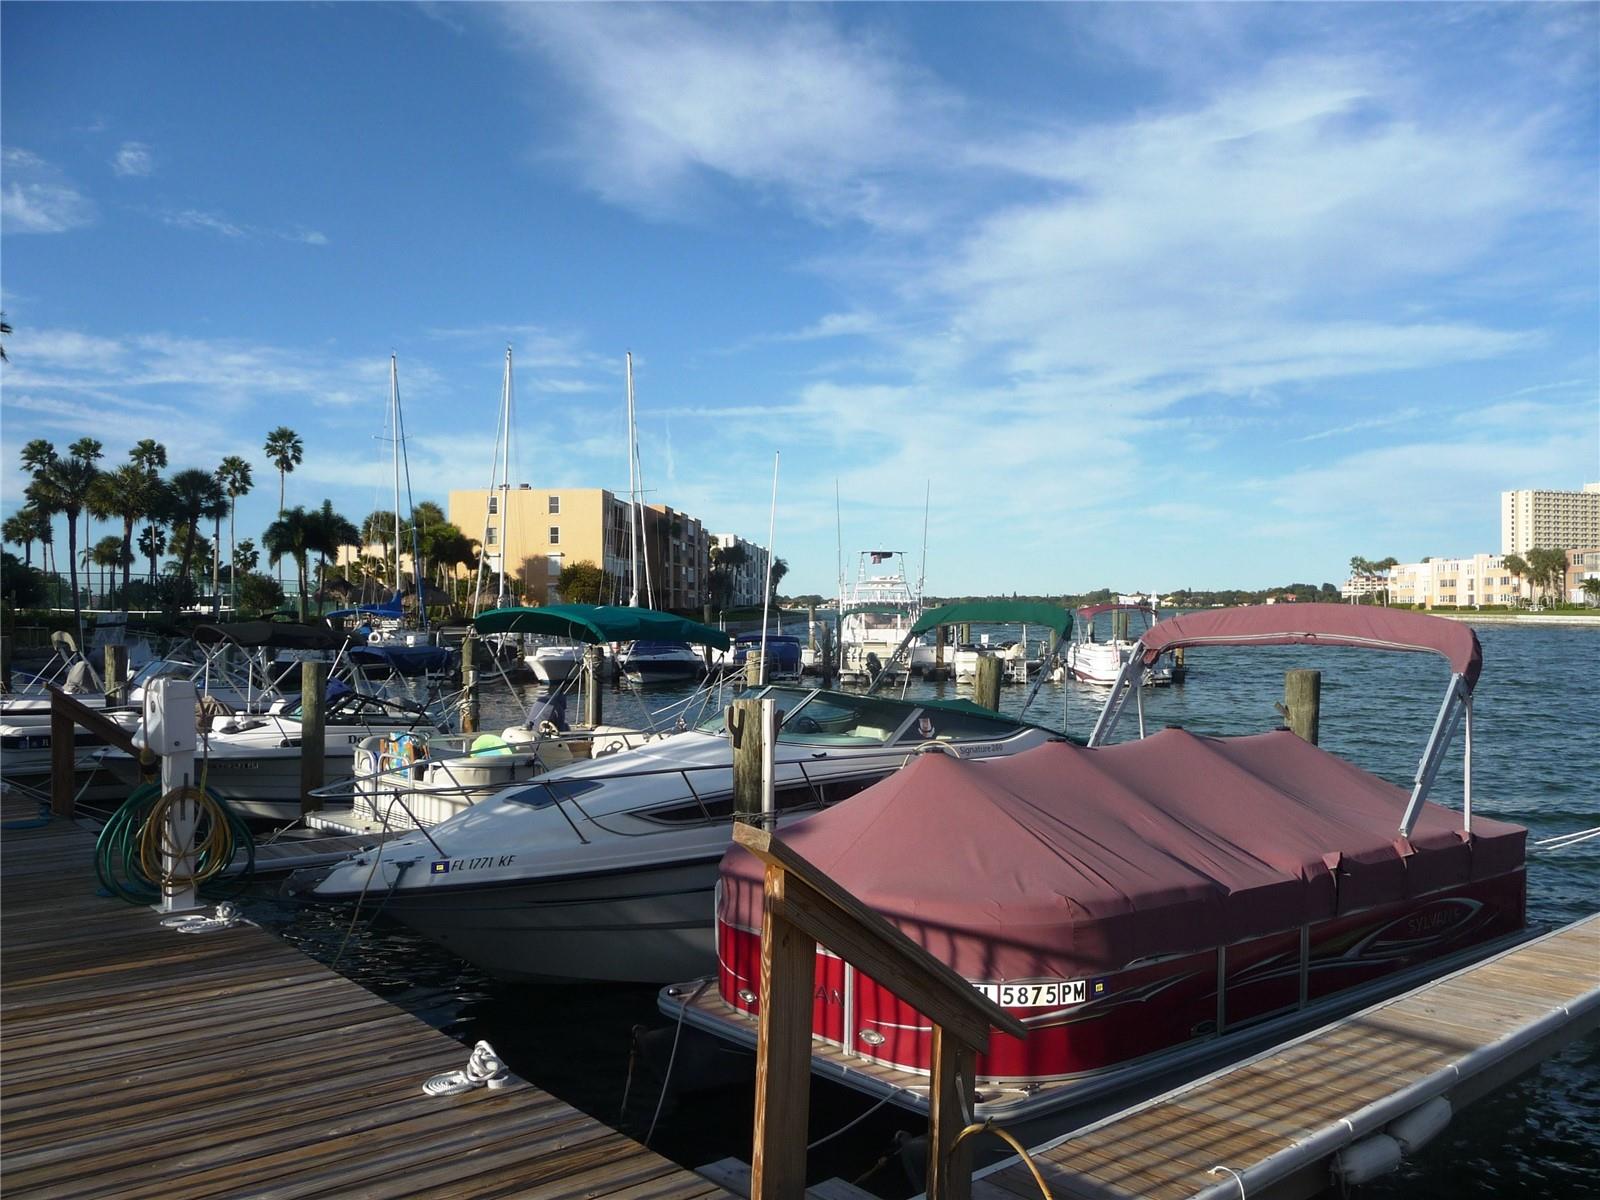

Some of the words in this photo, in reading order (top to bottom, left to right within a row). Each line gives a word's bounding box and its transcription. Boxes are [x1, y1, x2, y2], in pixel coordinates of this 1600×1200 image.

[960, 744, 991, 756] Signature
[451, 860, 465, 871] FL
[469, 857, 494, 870] 1771
[498, 855, 517, 867] KF
[1003, 986, 1057, 1005] 5875
[1062, 982, 1085, 1003] PM
